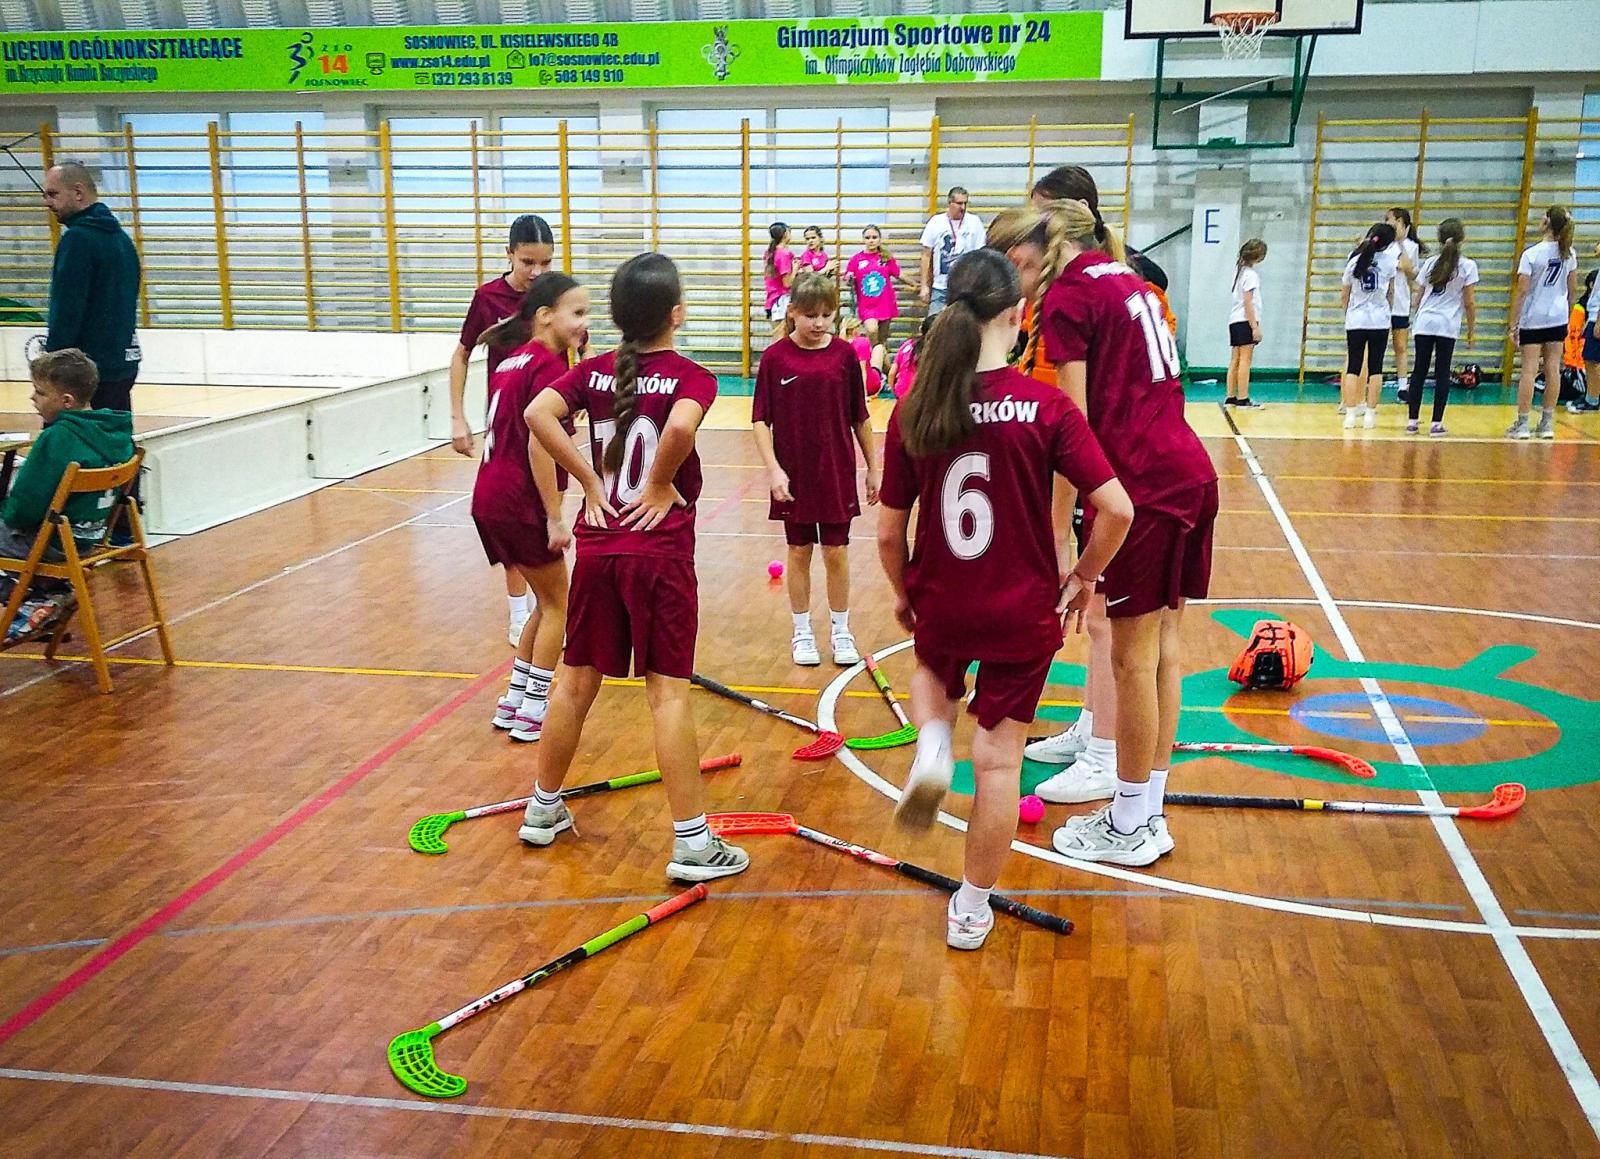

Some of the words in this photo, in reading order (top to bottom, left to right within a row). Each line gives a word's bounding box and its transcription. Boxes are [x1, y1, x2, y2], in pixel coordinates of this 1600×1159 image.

[501, 33, 599, 48] KISIELEWSKIEGO
[777, 26, 889, 48] Gimnazjum
[895, 23, 993, 48] Sportowe
[999, 24, 1020, 43] nr
[1025, 20, 1050, 42] 24
[3, 40, 65, 60] LICEUM
[70, 36, 243, 62] OGÓLNOKSZTAŁCĄCE
[318, 55, 348, 73] 14
[580, 69, 600, 83] 149
[603, 69, 624, 83] 910
[805, 55, 821, 75] im.
[825, 53, 895, 76] Olimpijczyków
[900, 52, 941, 76] Zagłębia
[945, 51, 1016, 75] Dąbrowskiego
[1204, 209, 1220, 243] E
[1544, 257, 1564, 287] 7
[588, 371, 679, 395] TWKÓW
[941, 452, 995, 561] 6
